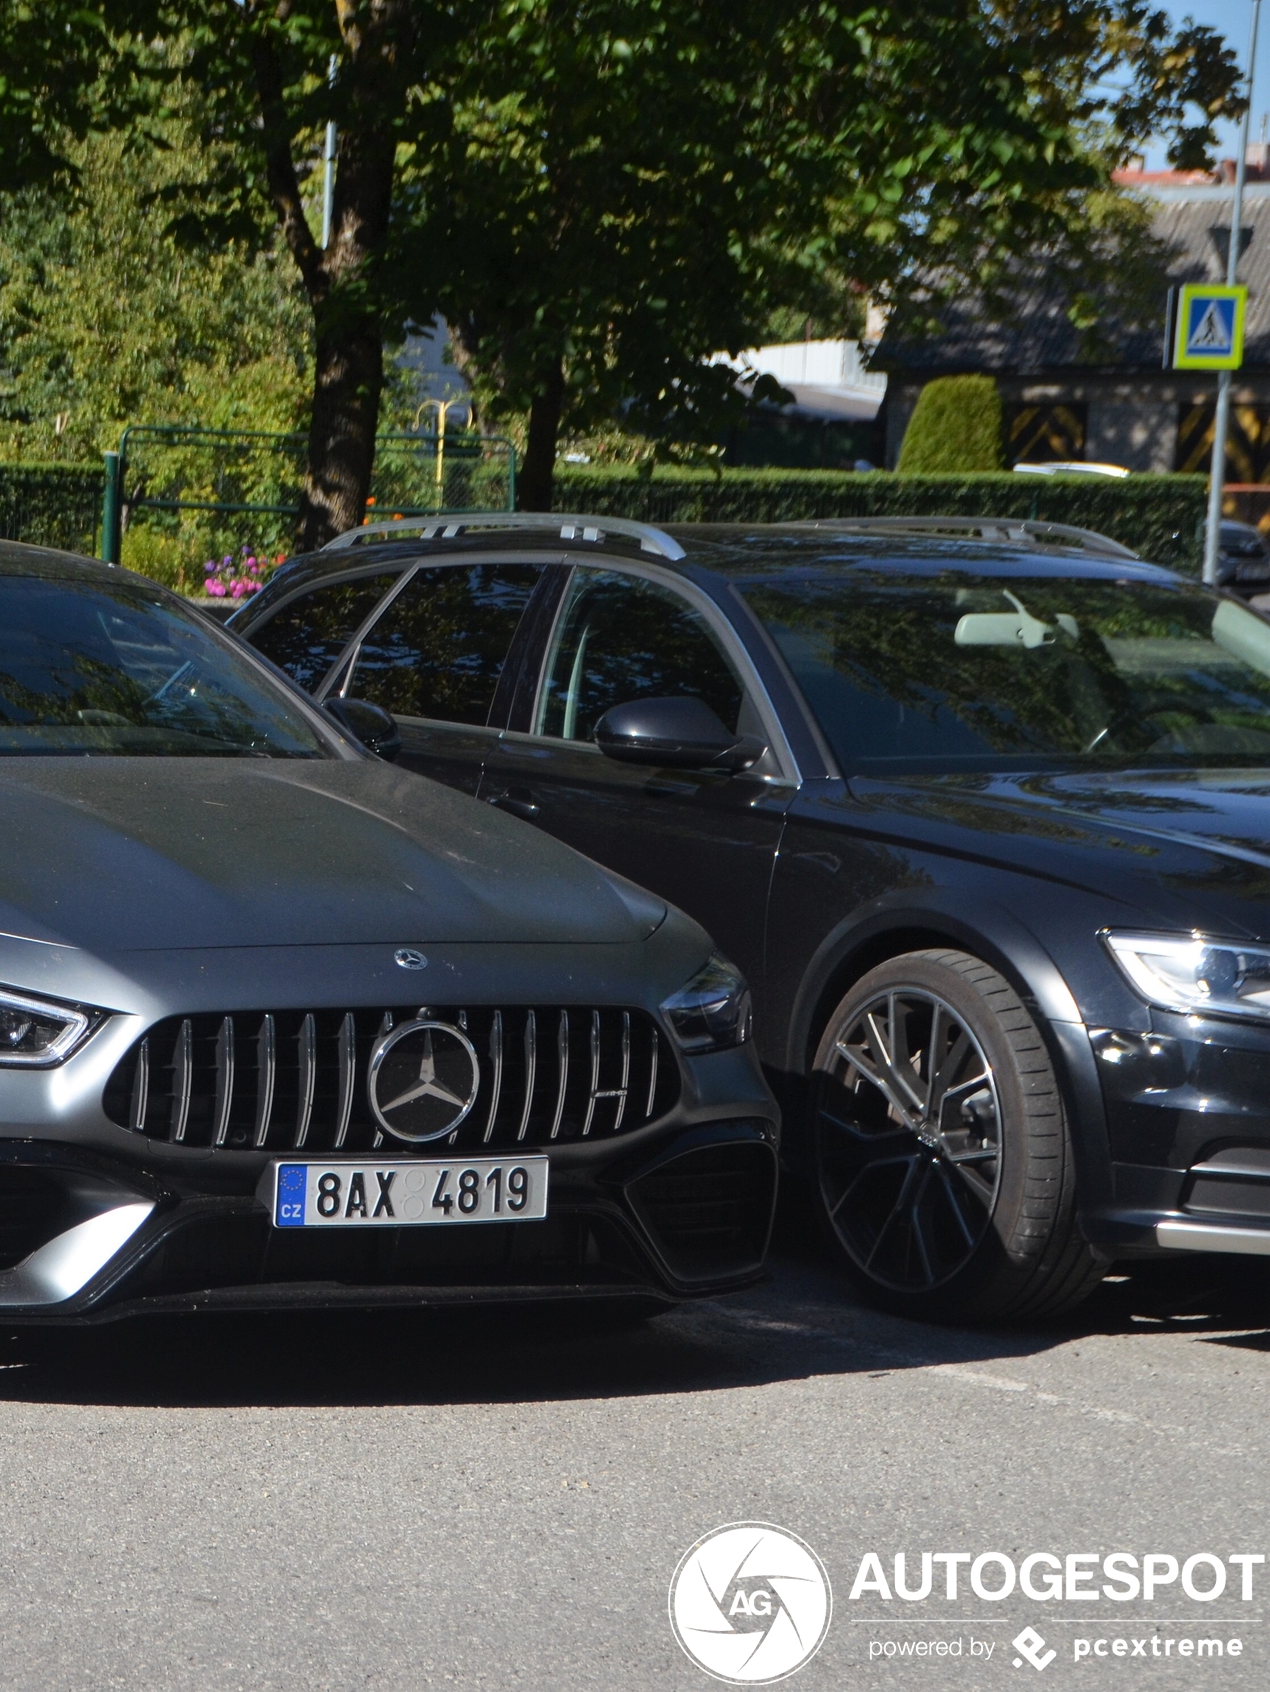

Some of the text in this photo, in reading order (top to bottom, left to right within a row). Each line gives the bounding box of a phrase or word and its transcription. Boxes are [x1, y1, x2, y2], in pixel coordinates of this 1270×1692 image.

[316, 1166, 529, 1219] 8AX 4819
[281, 1204, 302, 1219] CZ
